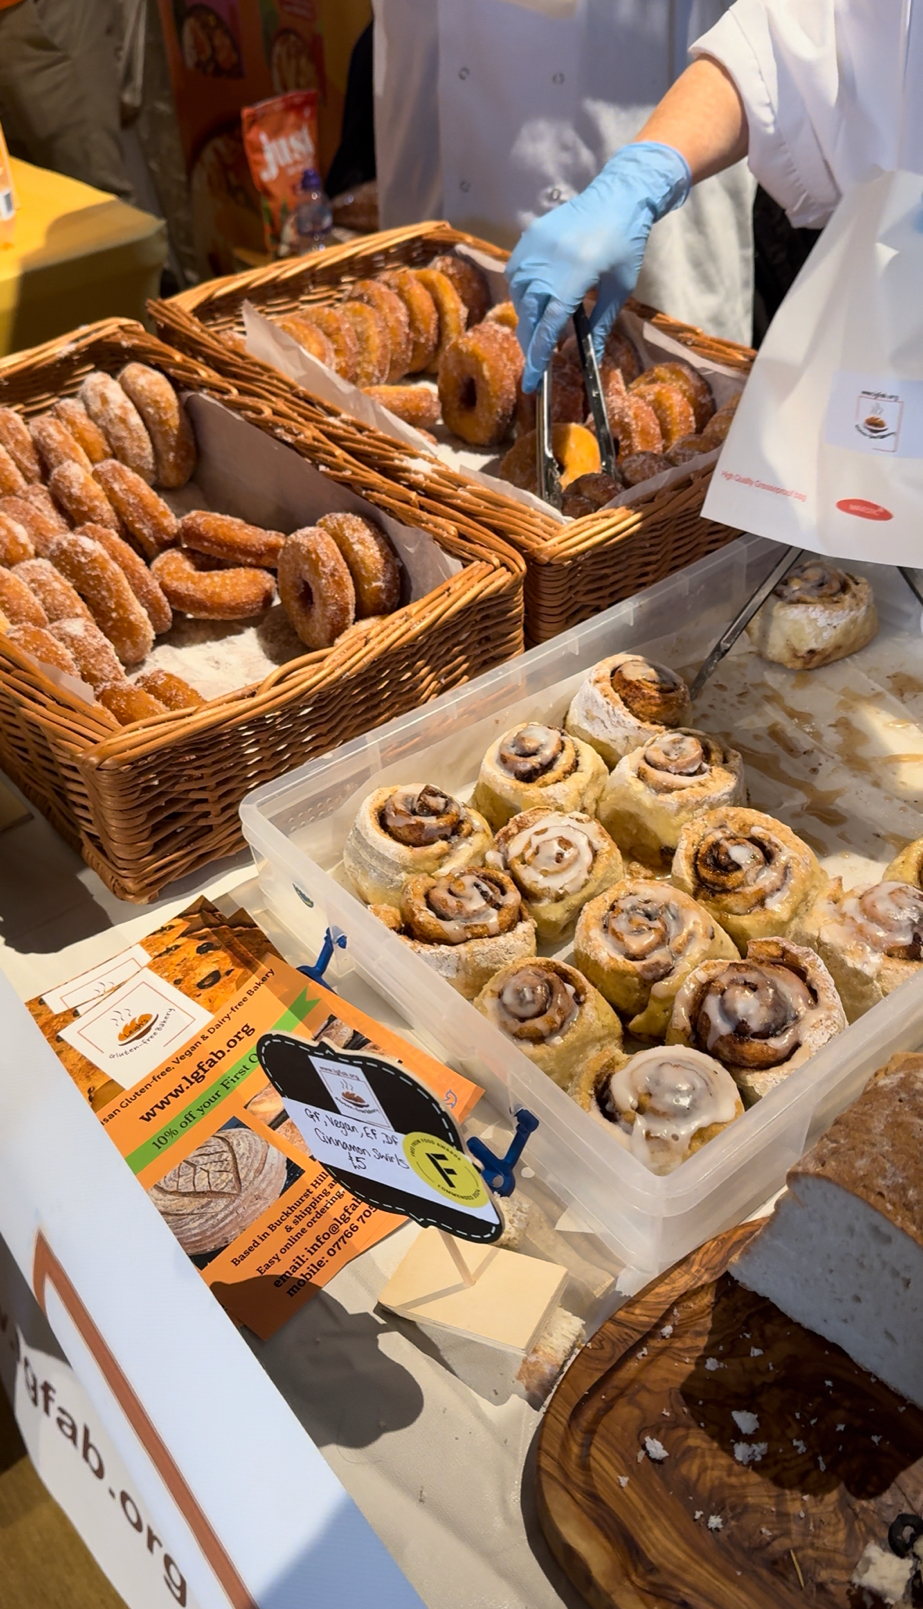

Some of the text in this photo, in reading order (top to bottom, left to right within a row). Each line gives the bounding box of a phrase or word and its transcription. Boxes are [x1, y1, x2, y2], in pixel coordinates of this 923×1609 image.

[119, 1064, 176, 1109] Gluten-free,
[171, 1041, 203, 1066] Vegan
[200, 1031, 210, 1042] &
[206, 996, 249, 1036] Dairy-free
[246, 968, 276, 998] Bakery
[124, 1018, 150, 1039] Leigh's
[138, 1022, 256, 1124] www.lgfab.org
[151, 1127, 180, 1151] 10%
[179, 1110, 198, 1130] off
[196, 1089, 222, 1117] your
[219, 1063, 252, 1091] First
[314, 1127, 372, 1157] Cinnamon
[347, 1151, 367, 1170] £5
[230, 1171, 329, 1267] Based in Buckhurst Hill
[284, 1223, 294, 1233] &
[290, 1188, 331, 1230] shipping
[255, 1253, 280, 1276] Easy
[279, 1226, 308, 1255] online
[273, 1253, 310, 1288] email:
[286, 1255, 330, 1298] mobile:
[326, 1222, 360, 1258] 07766
